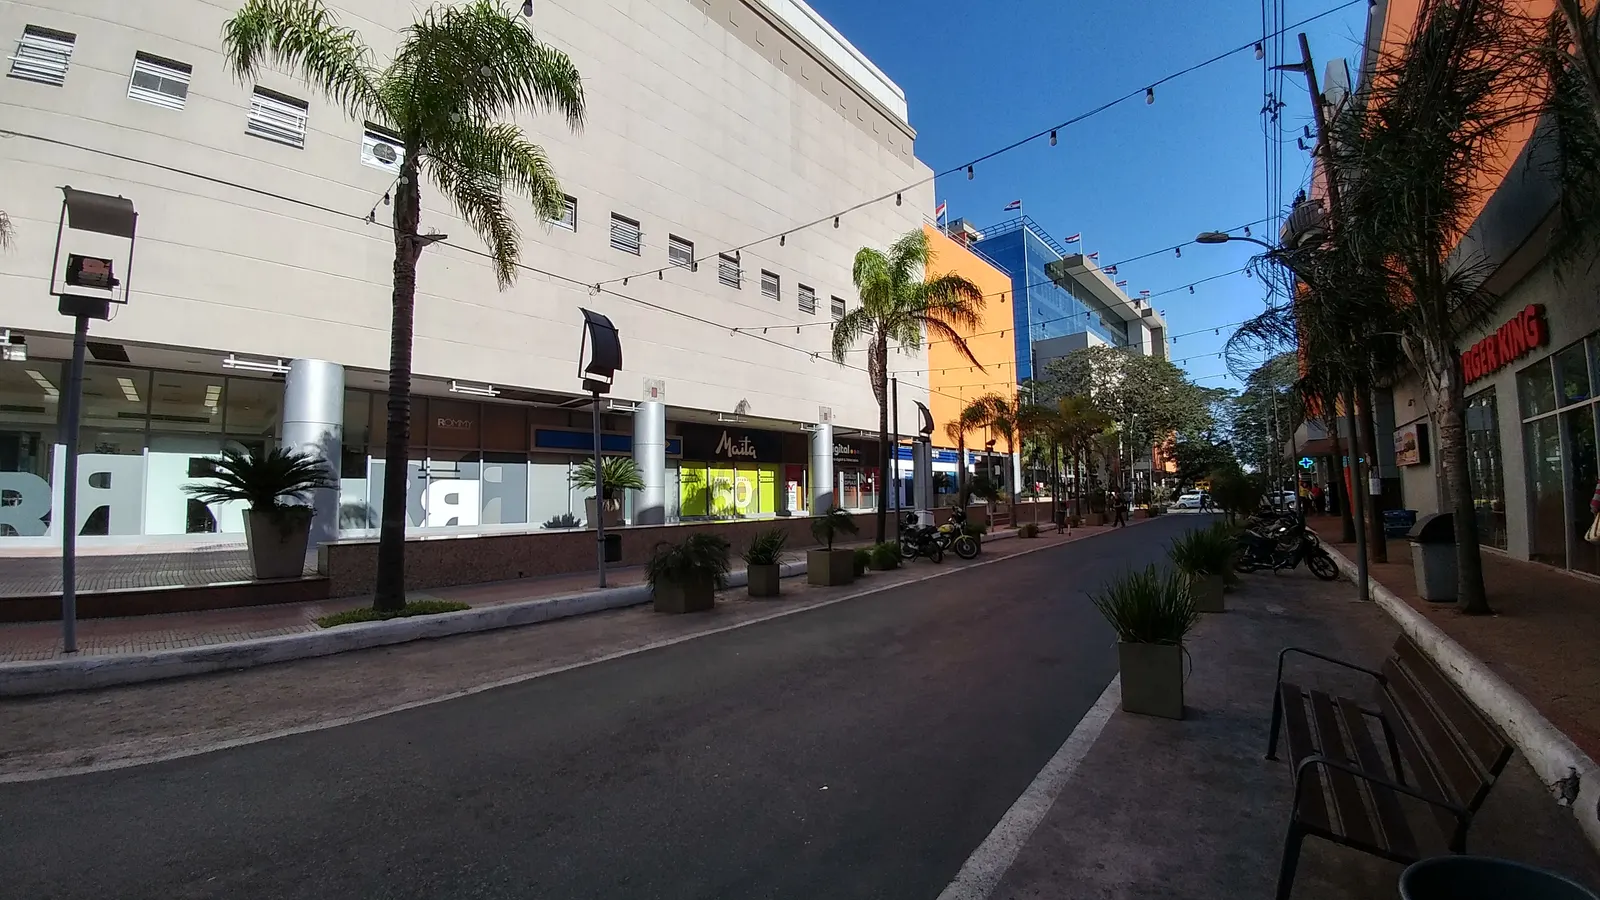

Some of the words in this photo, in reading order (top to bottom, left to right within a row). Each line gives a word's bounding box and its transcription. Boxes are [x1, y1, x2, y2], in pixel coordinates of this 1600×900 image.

[1496, 303, 1543, 366] KING
[437, 418, 474, 429] ROMMY
[715, 430, 757, 459] Maita
